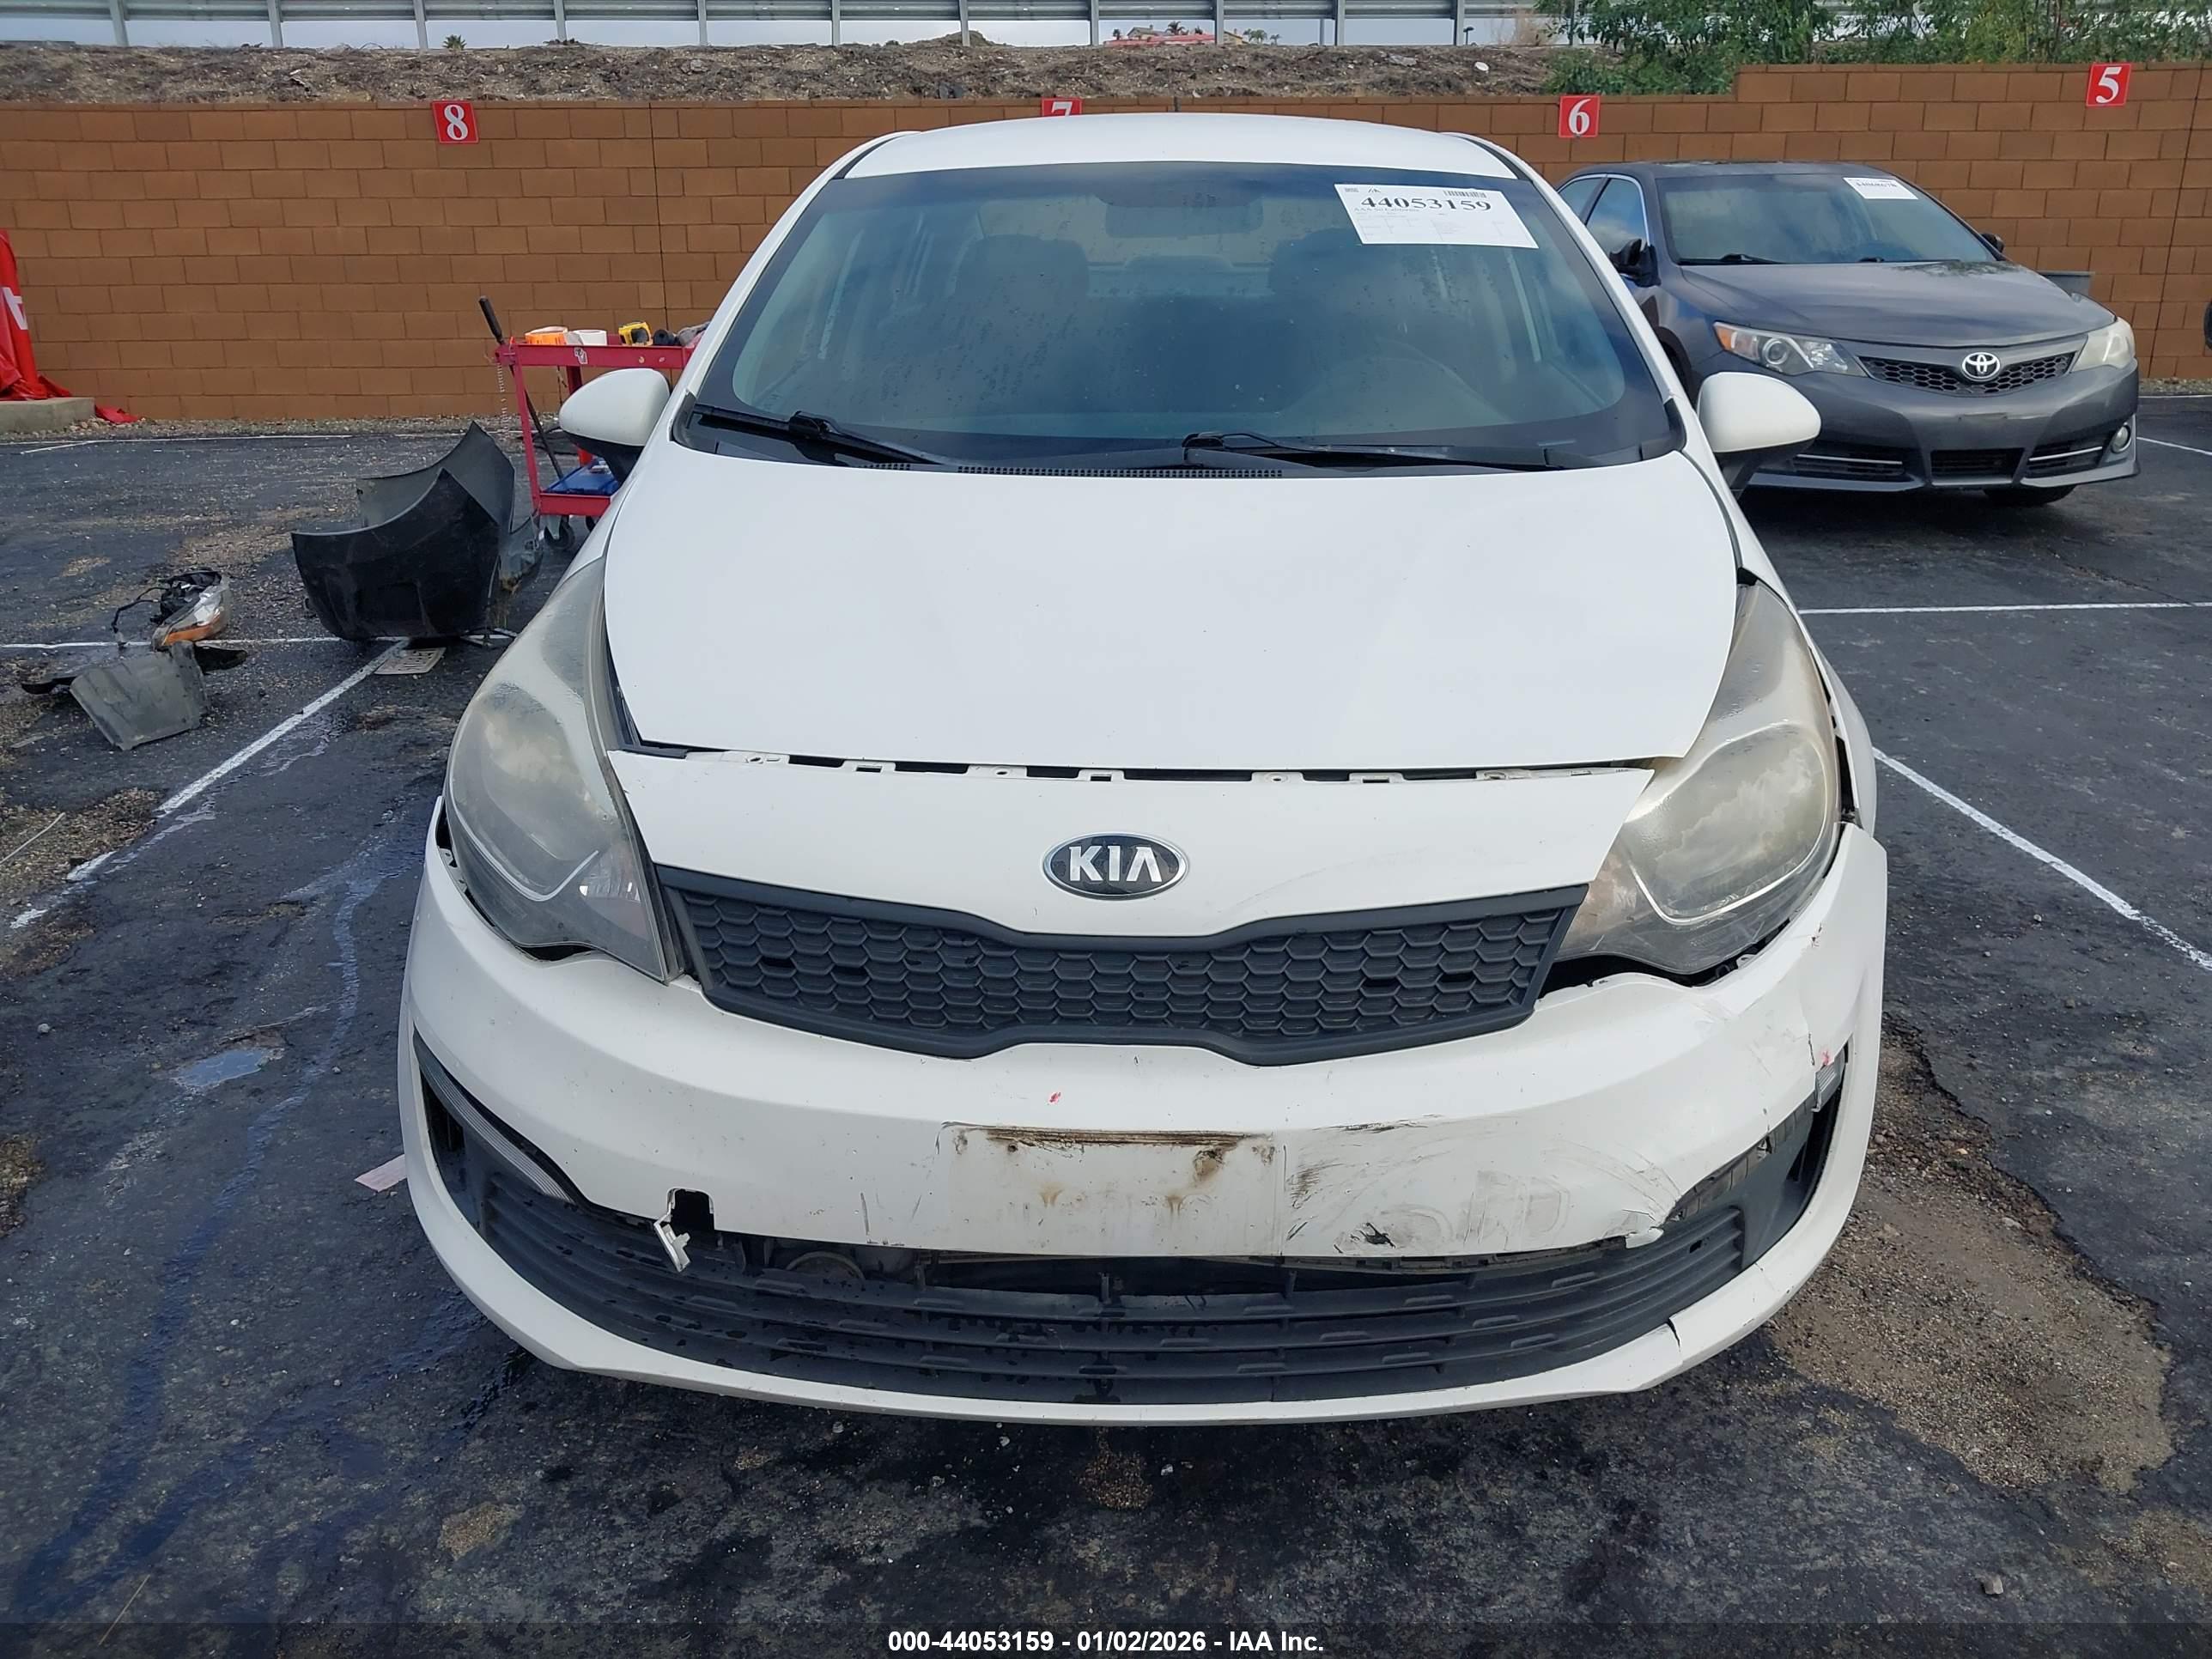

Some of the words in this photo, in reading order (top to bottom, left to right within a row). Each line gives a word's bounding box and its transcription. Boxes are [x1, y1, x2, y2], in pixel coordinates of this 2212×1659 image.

[2095, 66, 2122, 103] 5
[444, 104, 468, 141] 8
[1568, 98, 1590, 135] 6
[1361, 197, 1492, 211] 44053159
[1069, 845, 1163, 883] KIA
